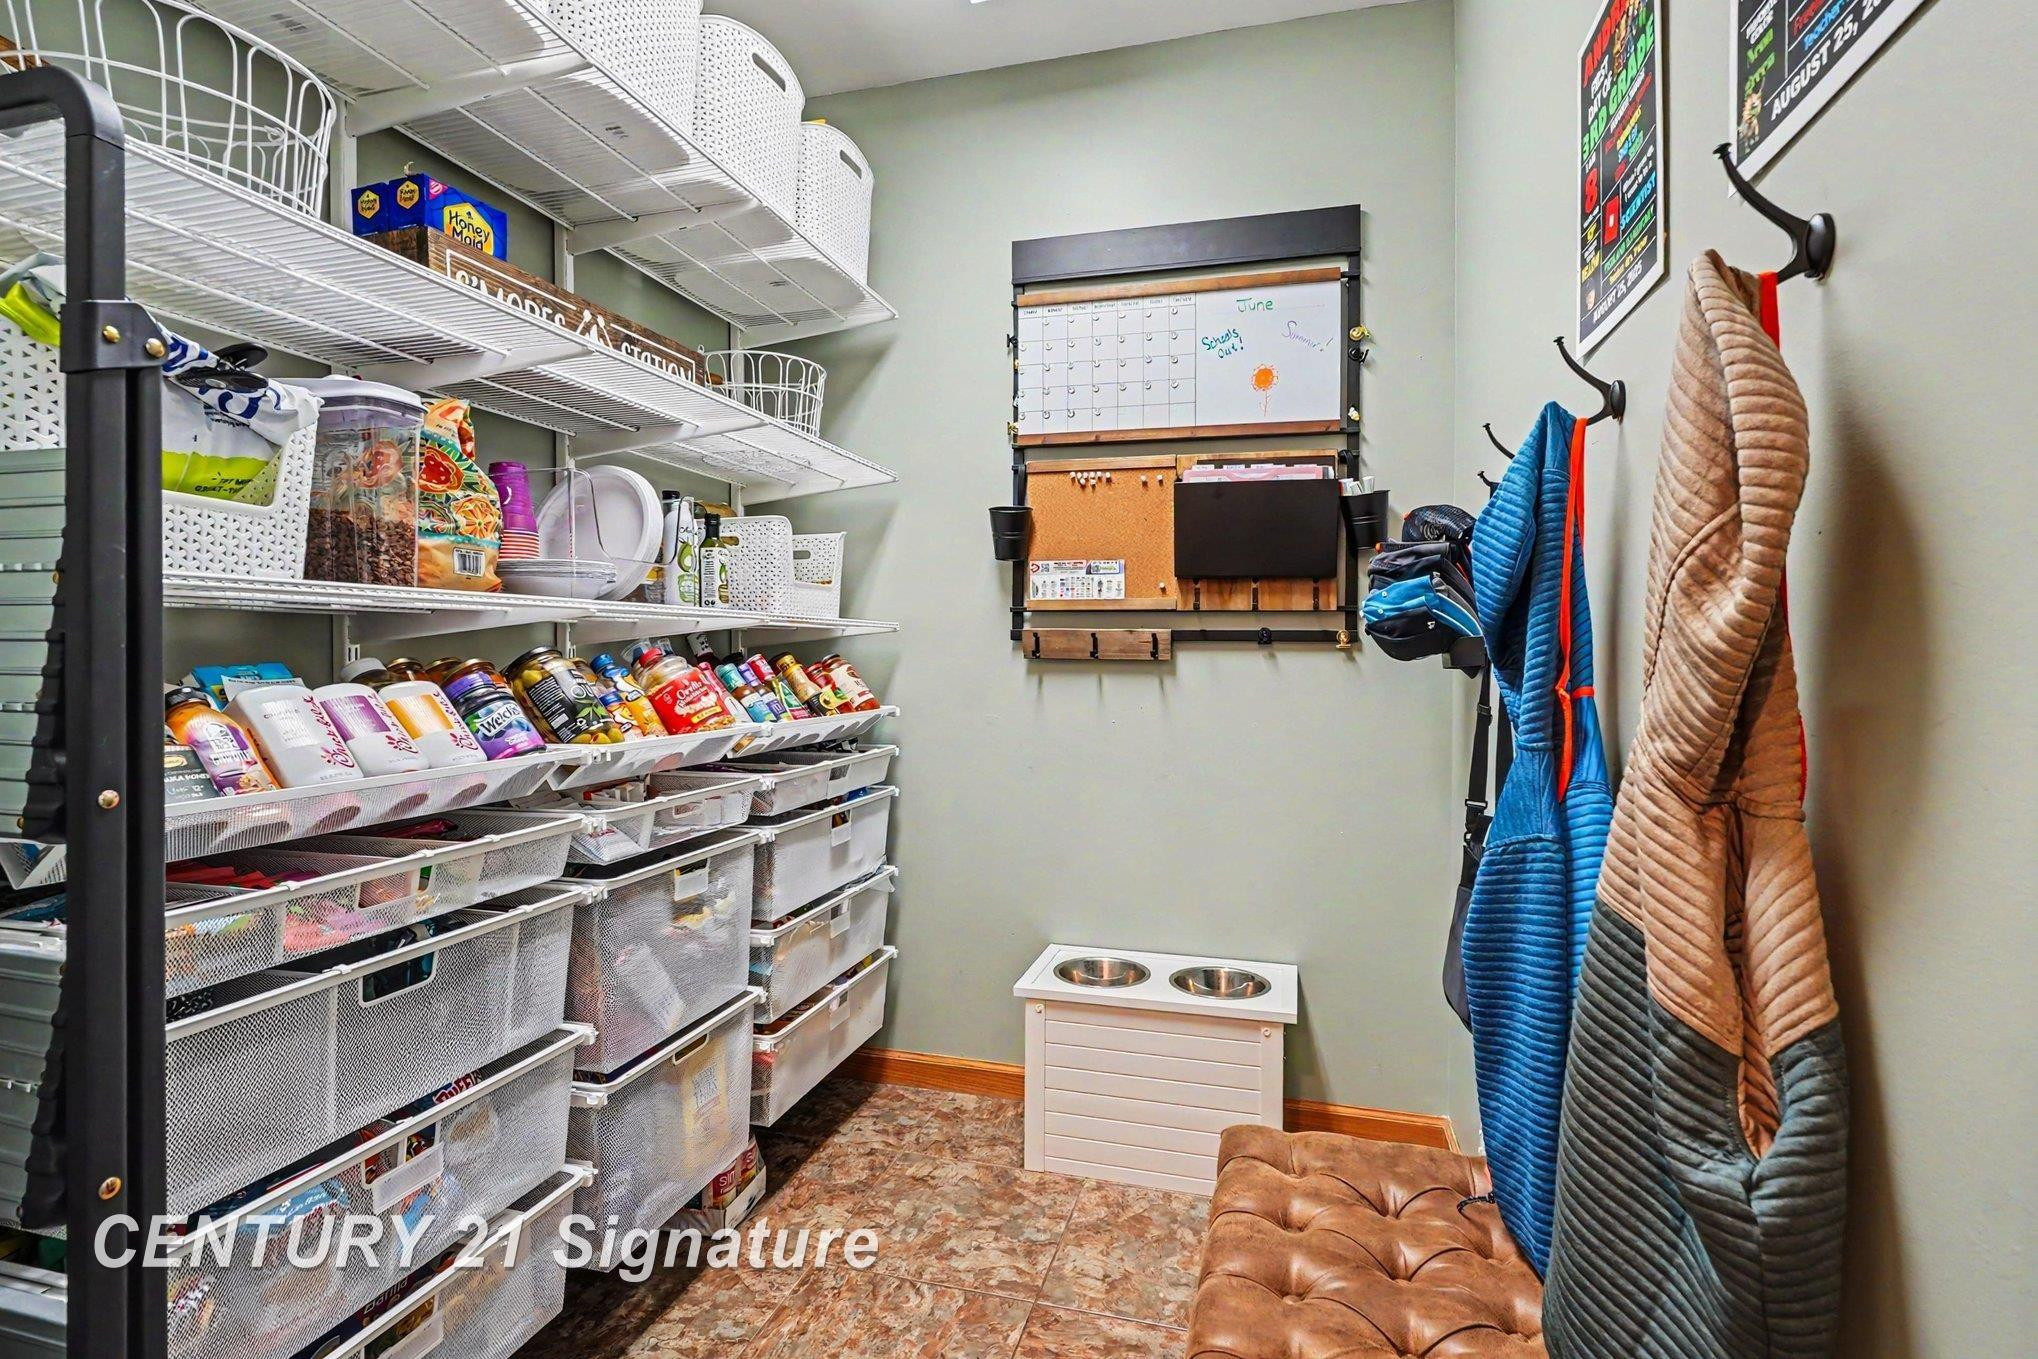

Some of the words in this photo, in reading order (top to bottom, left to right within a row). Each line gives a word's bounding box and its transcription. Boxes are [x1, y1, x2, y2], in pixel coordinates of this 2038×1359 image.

[1582, 105, 1607, 162] 3RD
[1609, 13, 1655, 116] GRADE
[1602, 70, 1613, 98] OF
[1771, 40, 1831, 121] AUGUST
[1833, 14, 1859, 53] 25,
[1584, 167, 1598, 214] 8
[1620, 171, 1656, 231] SCIENTIST
[449, 209, 490, 243] Honey
[452, 225, 484, 251] Maid
[1237, 297, 1274, 312] June
